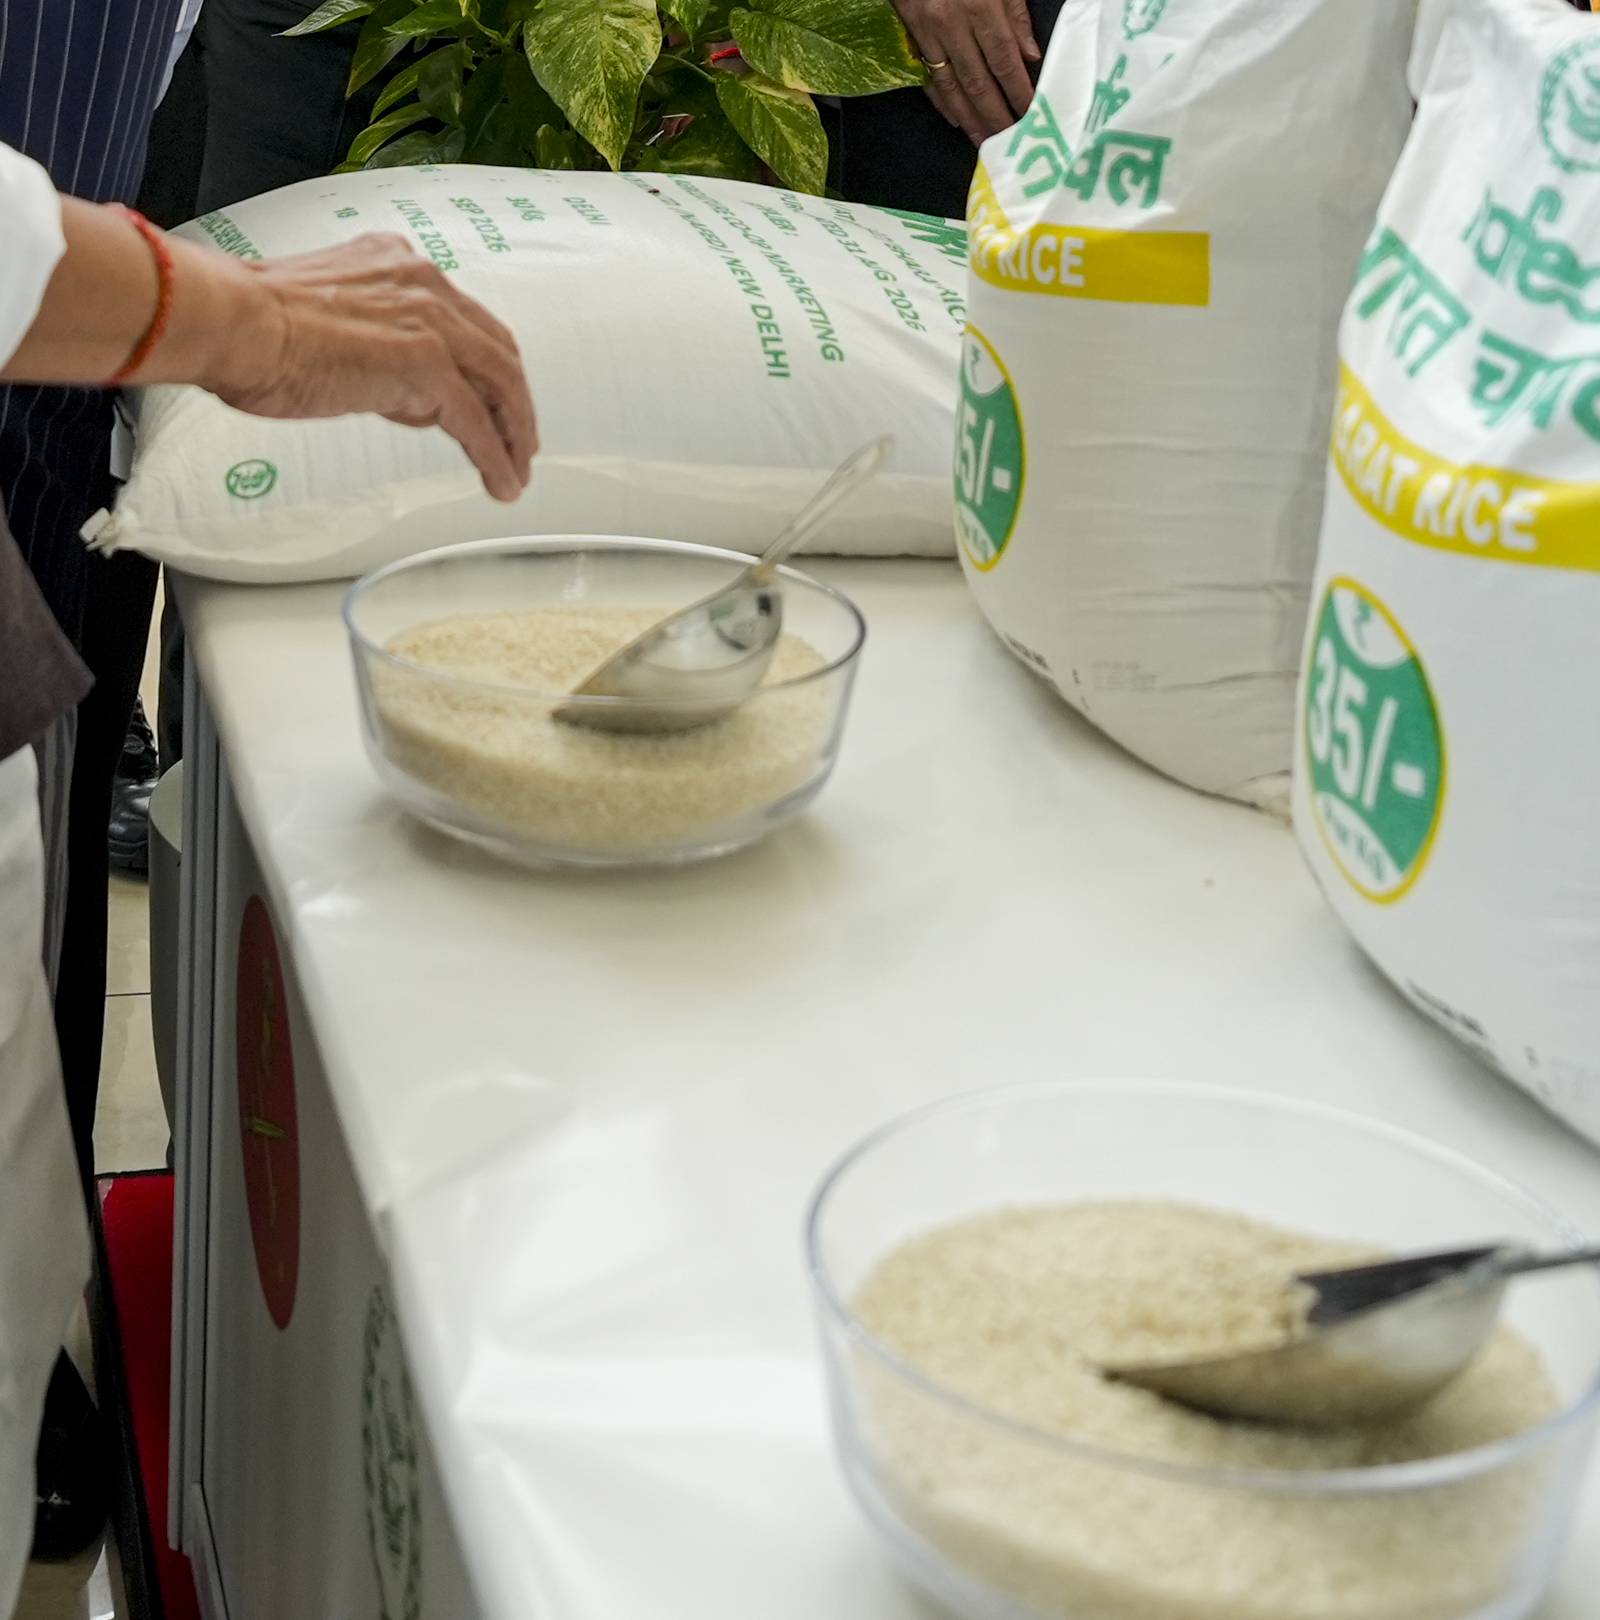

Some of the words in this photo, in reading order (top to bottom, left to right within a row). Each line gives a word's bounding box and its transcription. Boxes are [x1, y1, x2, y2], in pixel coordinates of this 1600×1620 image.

[391, 198, 435, 229] JUNE
[418, 230, 460, 272] 2028
[449, 196, 486, 215] SEP
[469, 216, 511, 253] 2026
[562, 196, 613, 226] DELHI
[998, 232, 1087, 289] RICE
[721, 255, 766, 300] NEW
[750, 302, 792, 379] DELHI
[759, 249, 845, 363] MARKETING
[883, 286, 928, 332] 2026
[955, 398, 1013, 508] 5/-
[1411, 468, 1546, 554] RICE
[1308, 633, 1427, 810] 35/-
